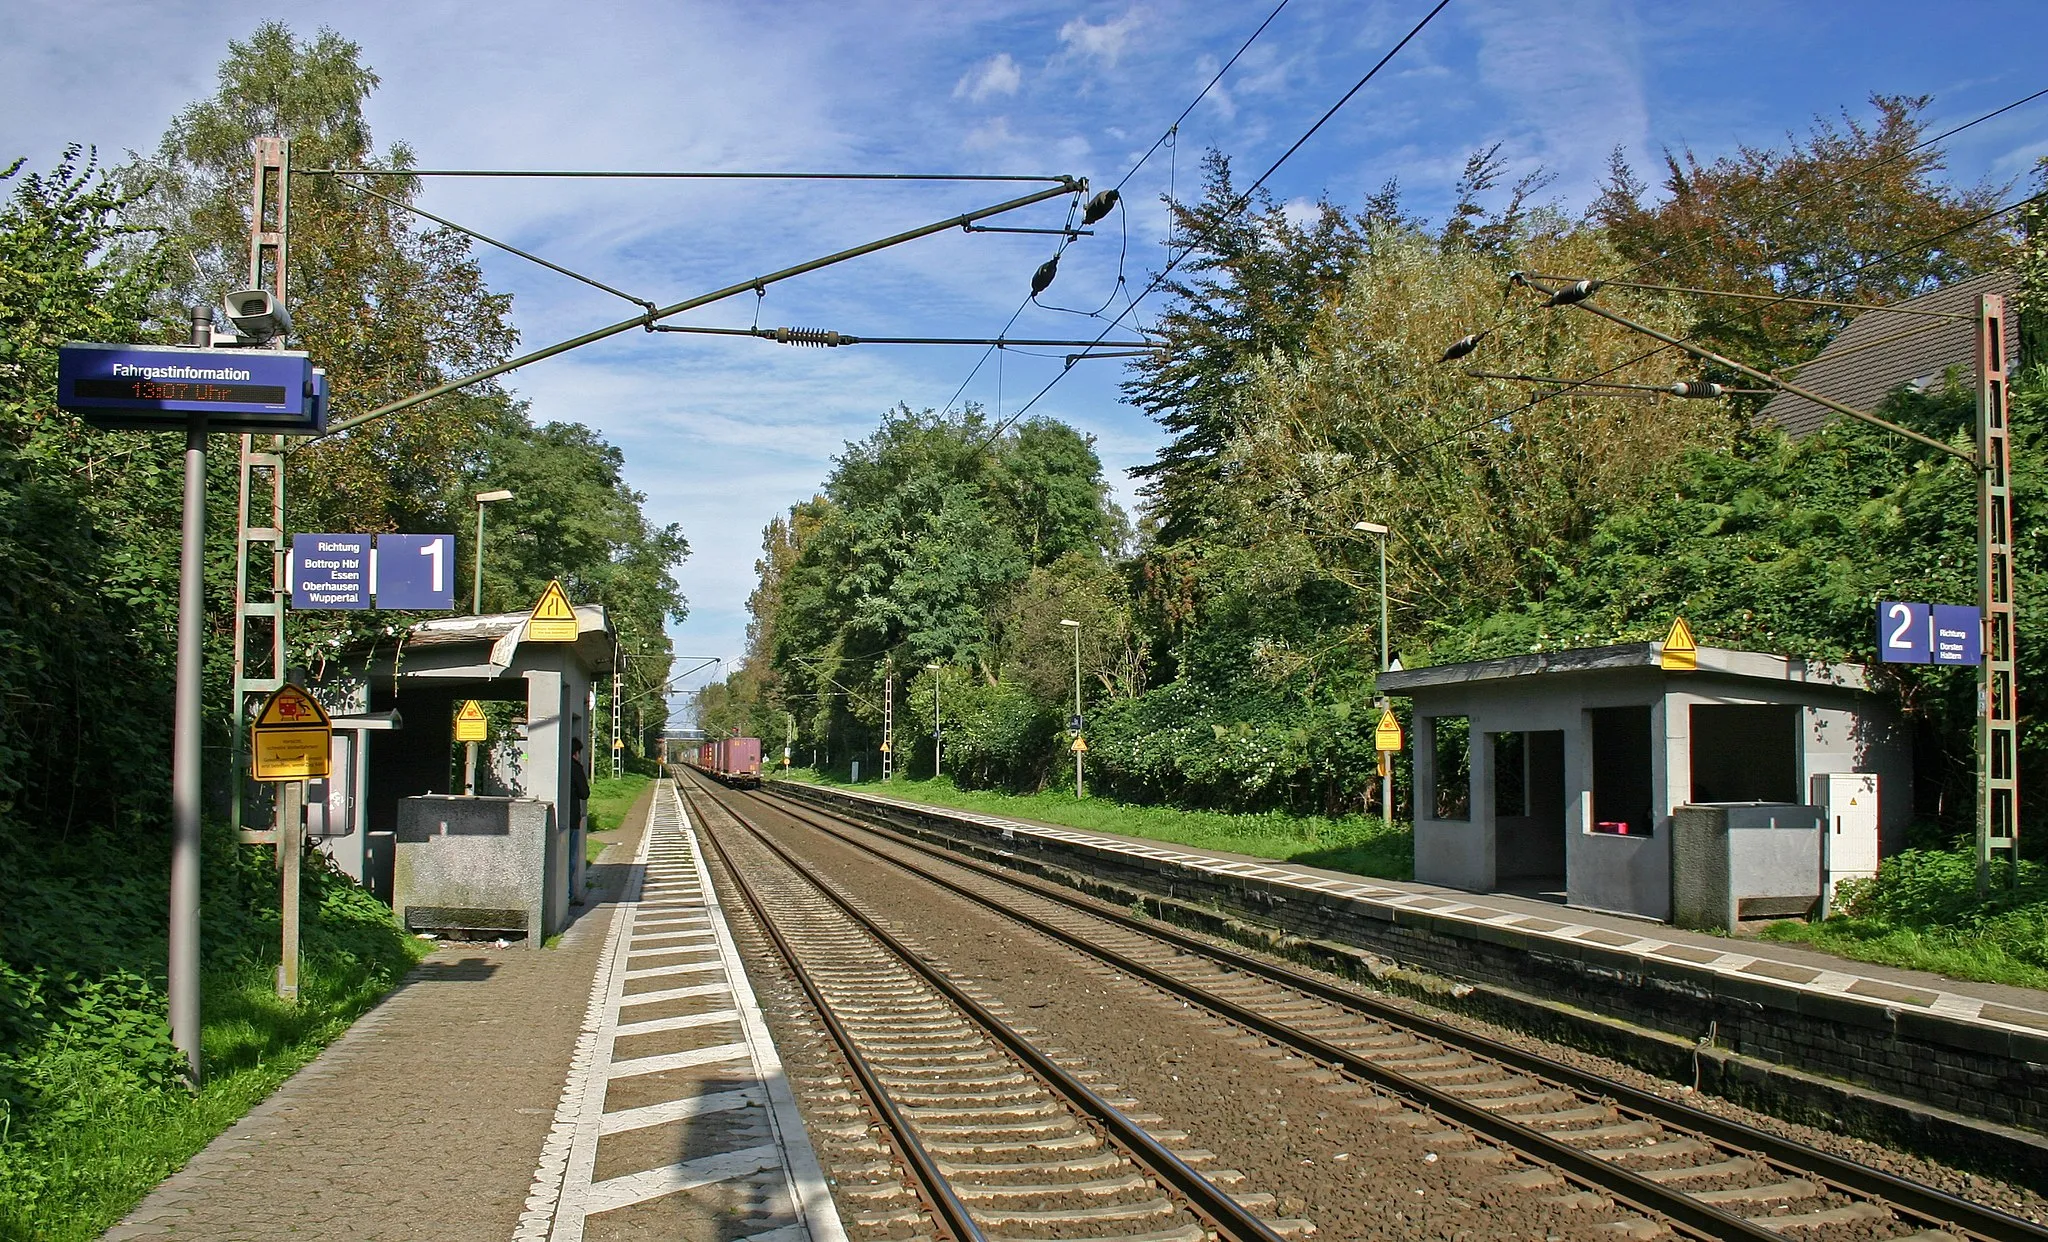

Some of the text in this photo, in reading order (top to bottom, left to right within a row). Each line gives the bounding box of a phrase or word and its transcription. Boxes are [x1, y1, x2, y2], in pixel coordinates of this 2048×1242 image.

[113, 363, 250, 381] Fahrgastinformation
[132, 382, 232, 401] 13:07 Uhr
[319, 542, 360, 554] Richtung
[304, 559, 360, 570] Bottrop Hbf
[420, 538, 443, 592] 1
[331, 570, 360, 580] Essen
[302, 581, 360, 592] Oberhausen
[309, 592, 359, 604] Wuppertal
[1889, 604, 1912, 648] 2
[1940, 629, 1966, 639] Richtung
[1940, 643, 1963, 651] Dorsten
